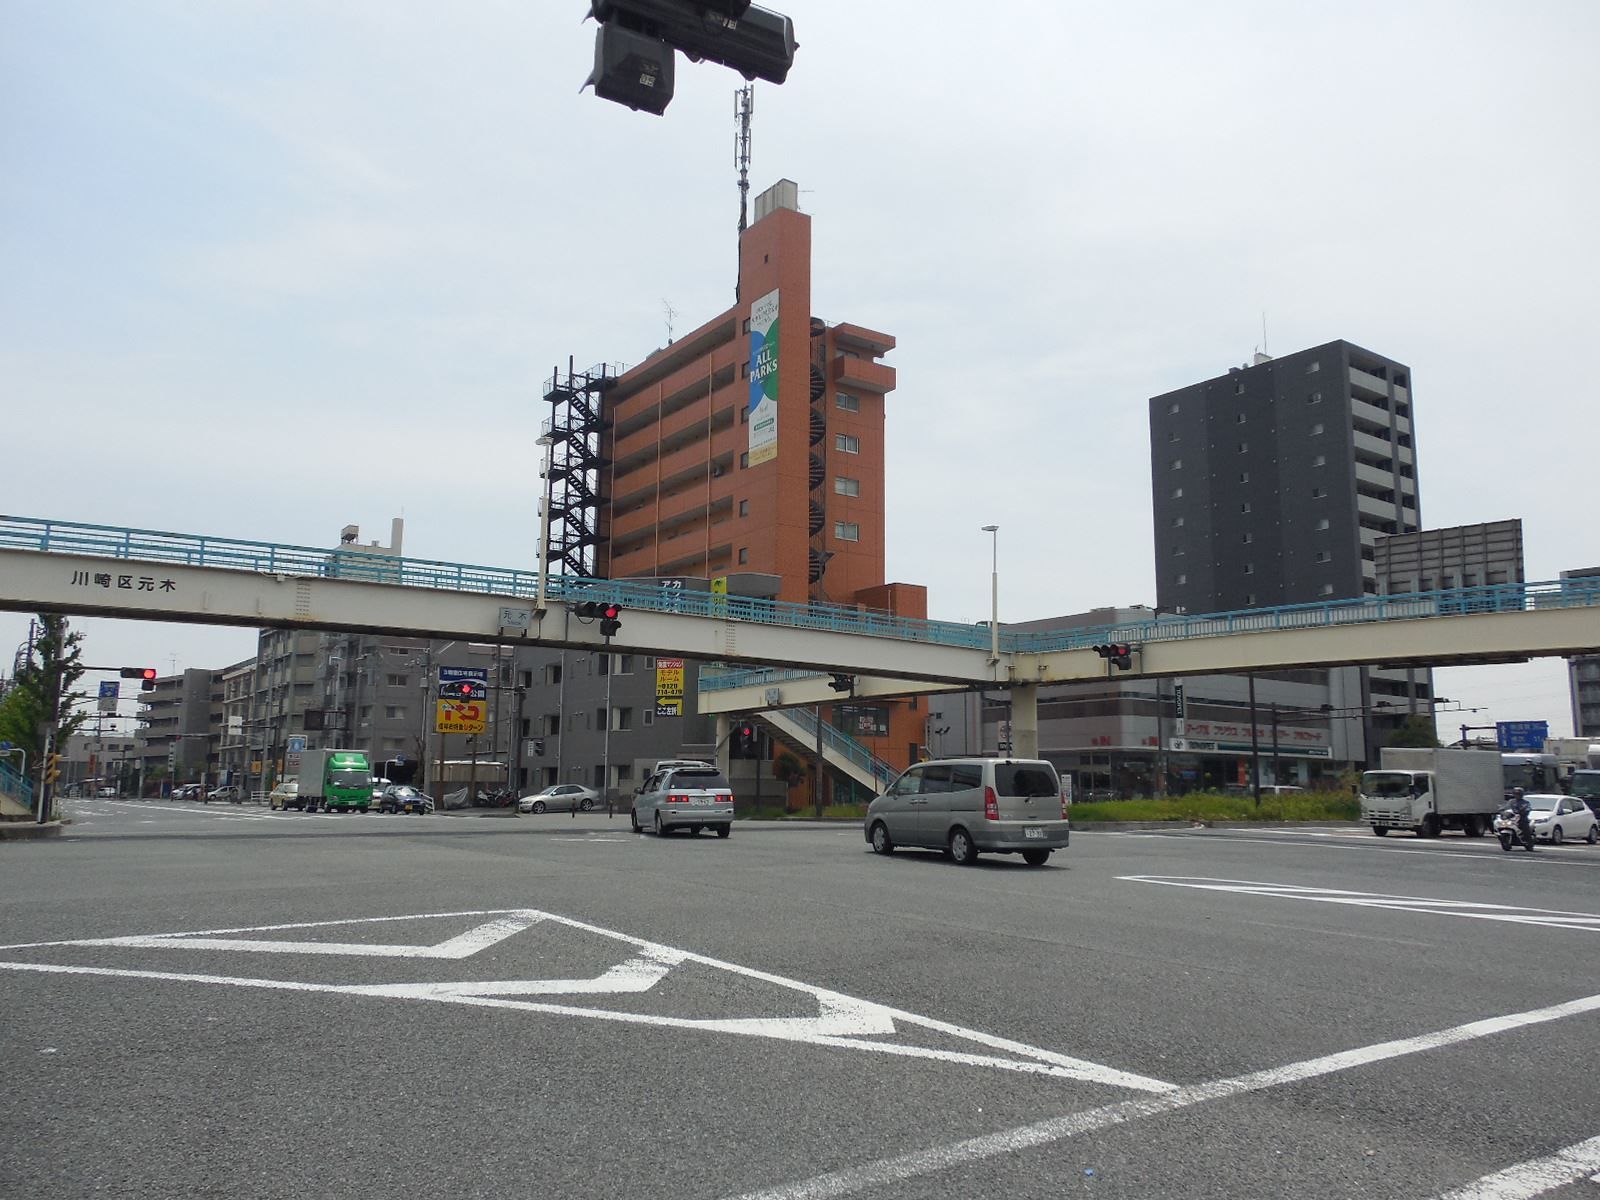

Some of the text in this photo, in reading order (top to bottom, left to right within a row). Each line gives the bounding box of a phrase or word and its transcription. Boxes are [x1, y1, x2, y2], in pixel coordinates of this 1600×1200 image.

[756, 350, 772, 367] ALL
[750, 358, 778, 384] PARKS
[71, 570, 176, 592] 川崎区元木
